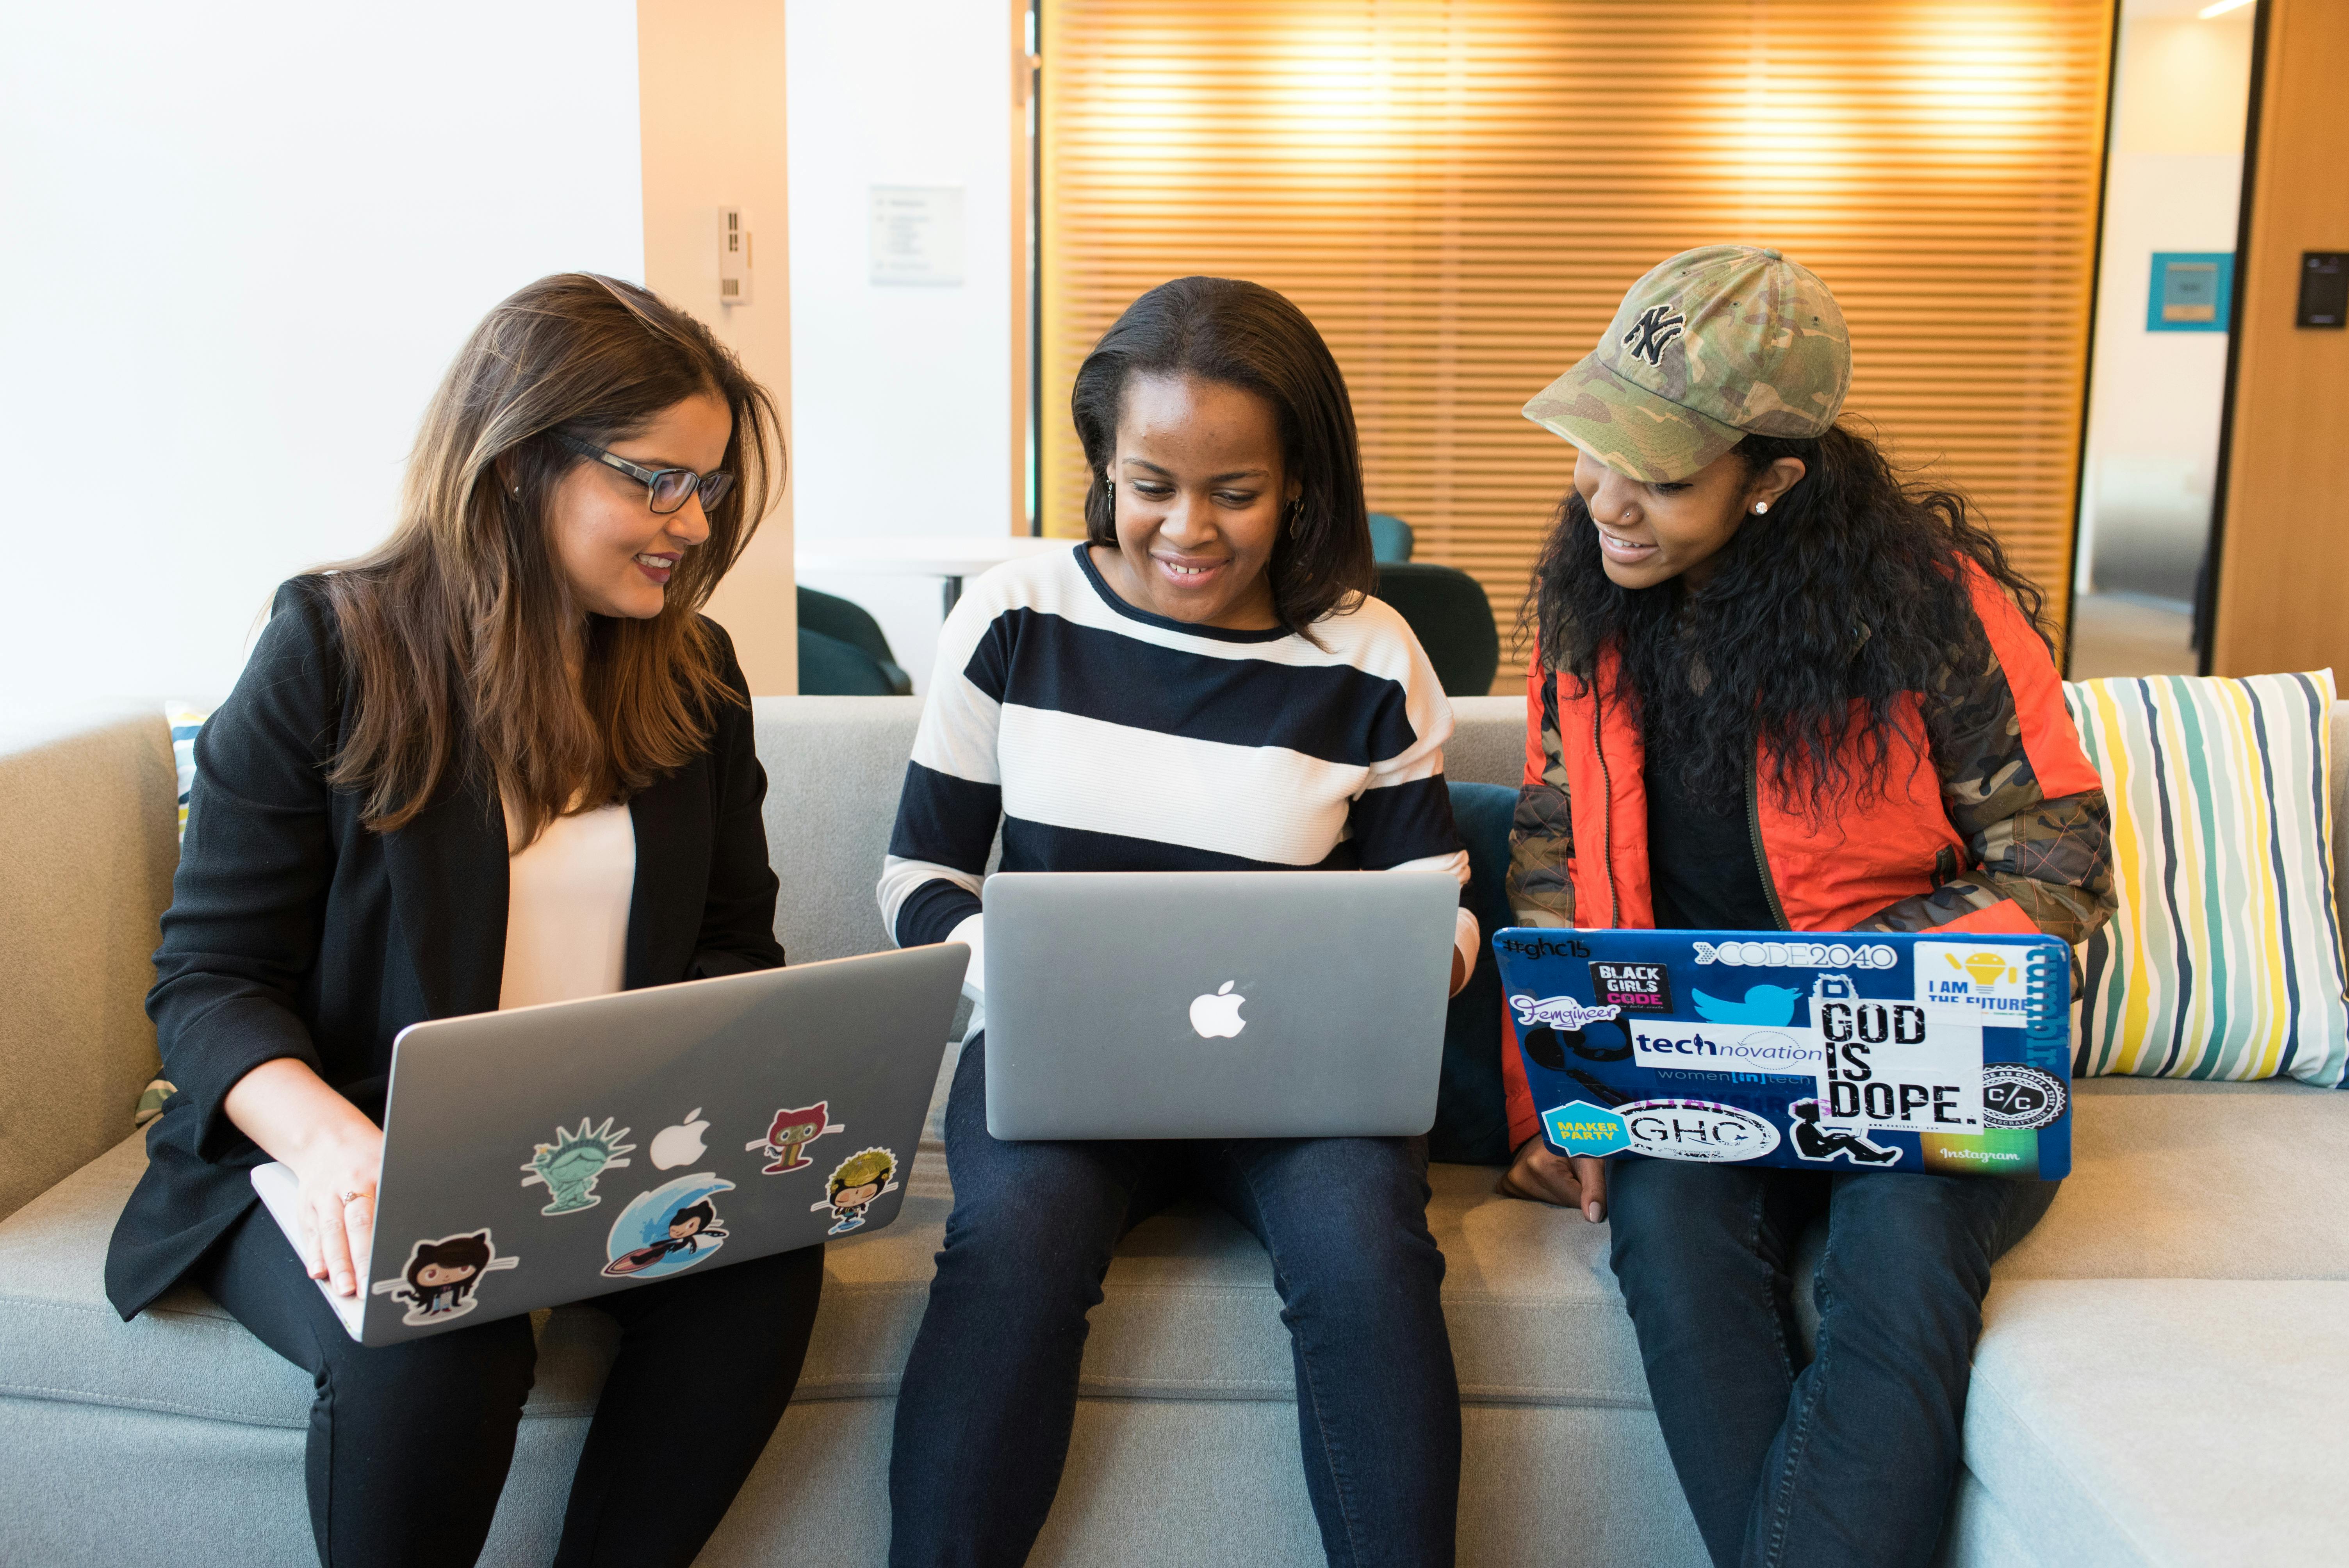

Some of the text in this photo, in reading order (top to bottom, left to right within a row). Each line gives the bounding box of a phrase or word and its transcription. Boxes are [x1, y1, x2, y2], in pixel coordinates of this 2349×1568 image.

[1502, 938, 1591, 960] #ghc15
[1719, 944, 1893, 967] CODE2040
[1599, 966, 1660, 980] BLACK
[1607, 979, 1658, 992] GIRLS
[1929, 980, 1968, 994] I AM
[1607, 992, 1663, 1005] CODE
[1514, 998, 1616, 1028] Femgineer
[1822, 1003, 1926, 1045] GOD
[1826, 1042, 1872, 1082] IS
[2016, 1072, 2046, 1085] CRAFT
[1829, 1081, 1977, 1124] DOPE.
[1983, 1112, 2048, 1125] DEASCRAFT.COM
[1557, 1121, 1619, 1131] MAKER
[1631, 1117, 1747, 1147] GHC
[1561, 1131, 1614, 1140] PARTY
[1940, 1148, 2020, 1163] Instagram
